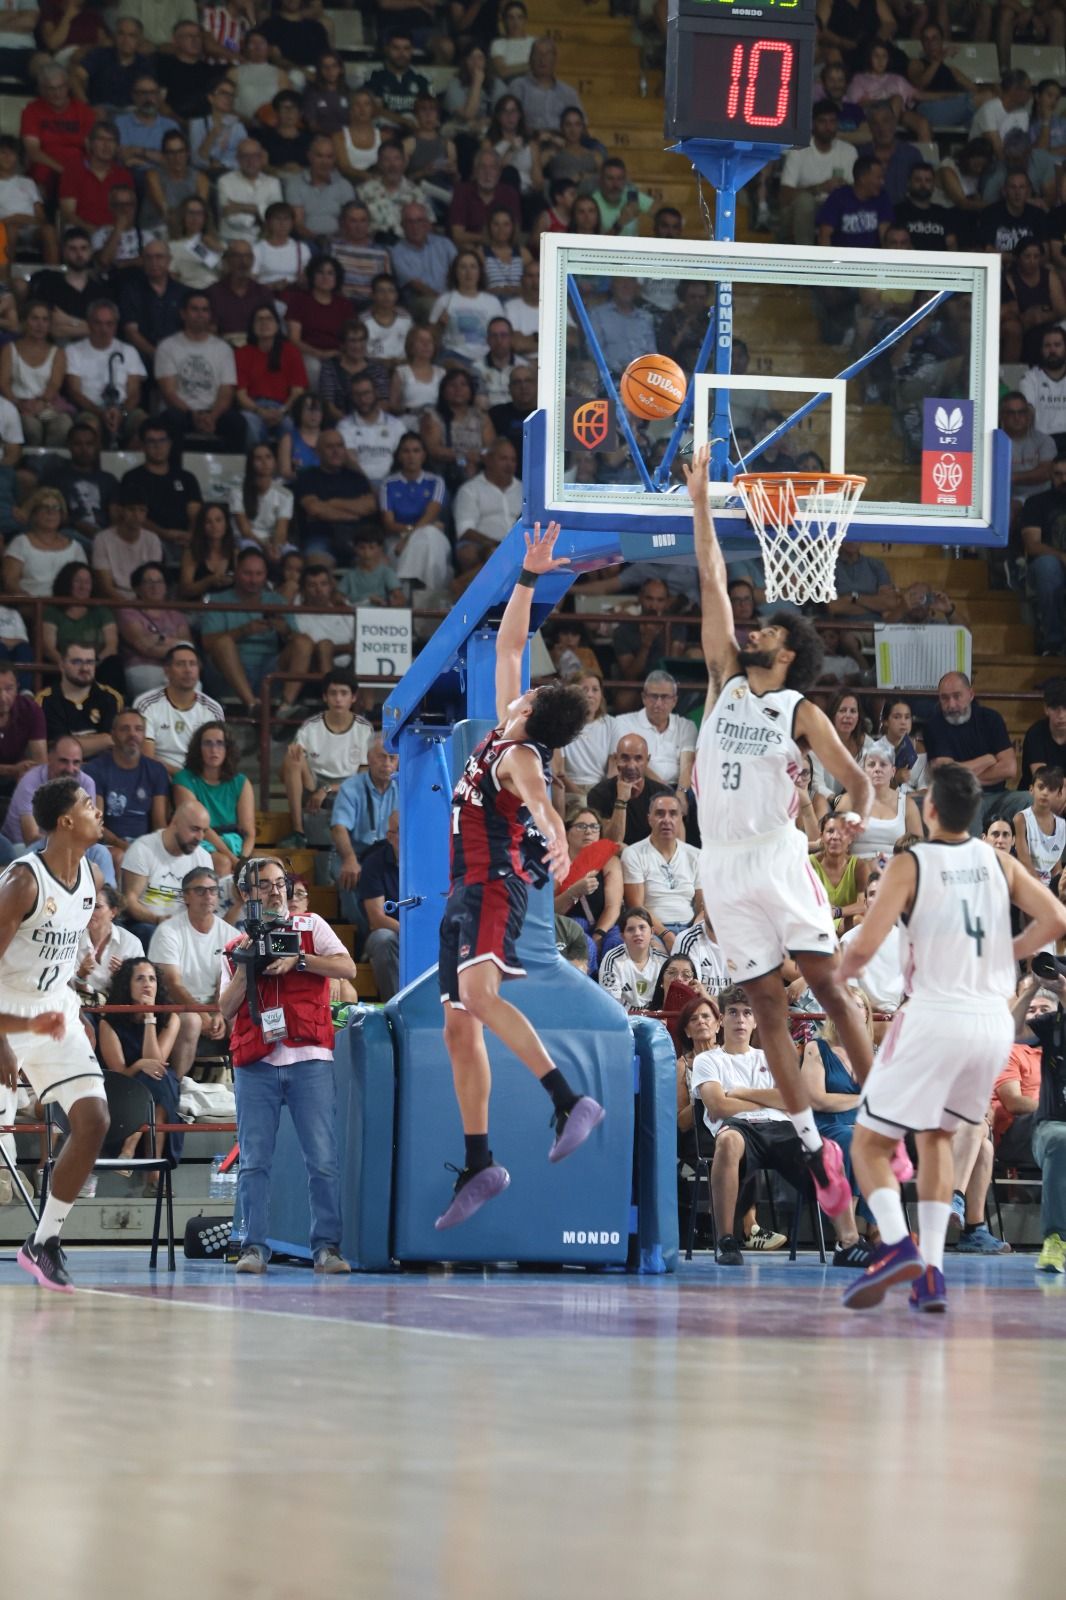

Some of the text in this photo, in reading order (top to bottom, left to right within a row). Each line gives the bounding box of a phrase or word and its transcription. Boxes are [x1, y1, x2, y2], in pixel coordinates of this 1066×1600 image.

[731, 8, 763, 17] MONDO
[727, 41, 793, 126] 10
[719, 281, 732, 348] MONDO
[647, 372, 682, 400] Wilson
[652, 533, 676, 548] MONDO
[361, 624, 409, 637] FONDO
[362, 642, 408, 654] NORTE
[376, 657, 396, 676] D
[716, 717, 784, 745] Emirates
[721, 762, 742, 791] 33
[961, 899, 985, 958] 4
[563, 1231, 620, 1244] MONDO
